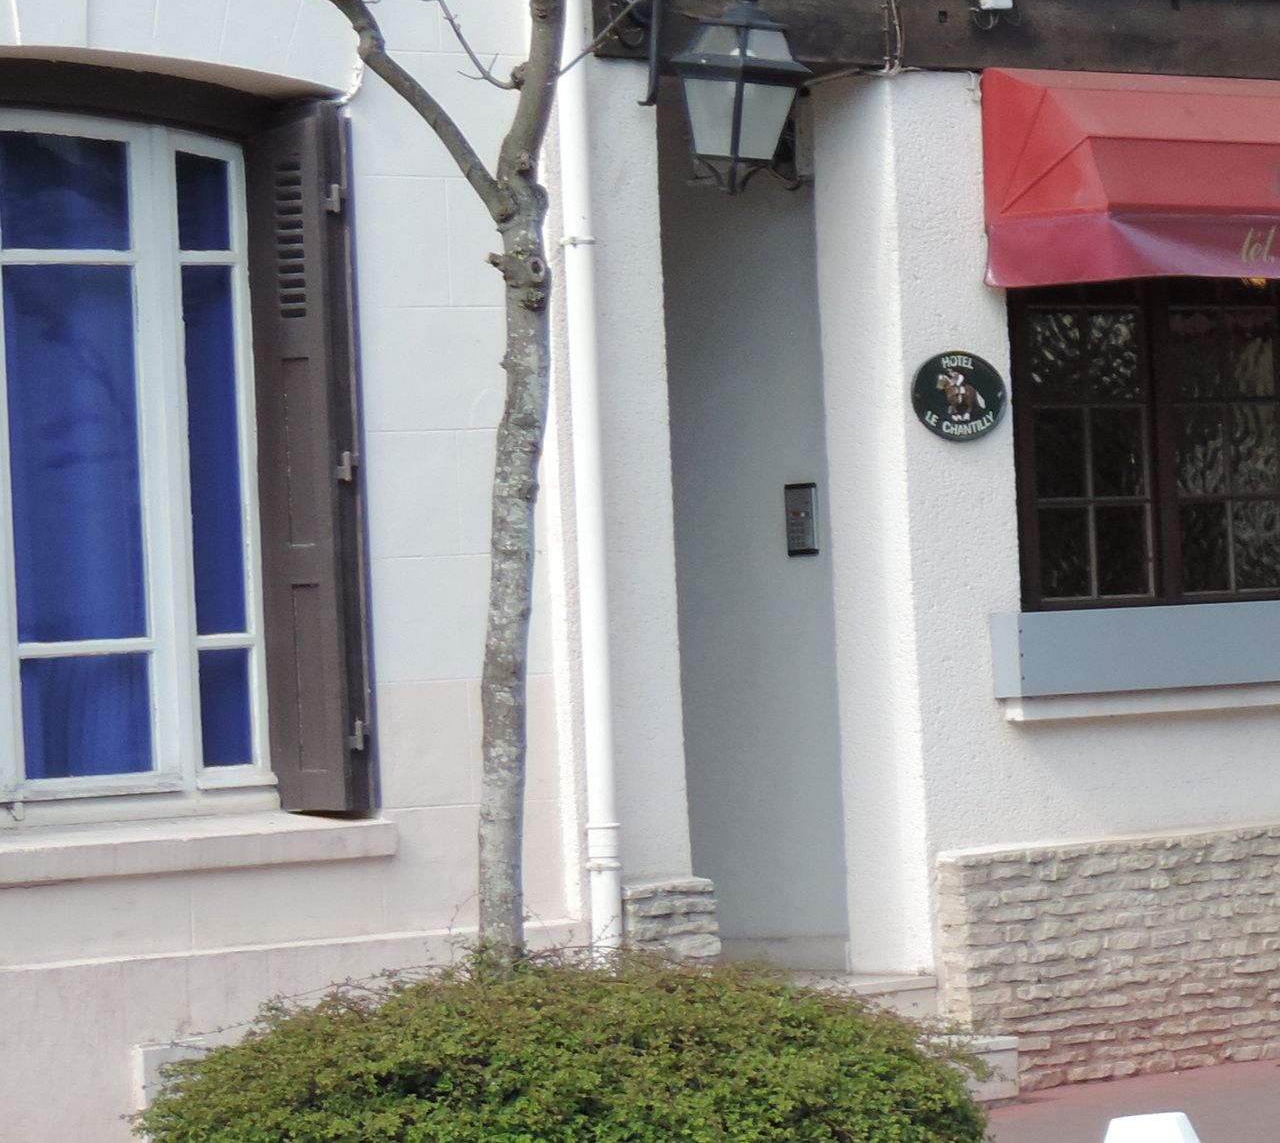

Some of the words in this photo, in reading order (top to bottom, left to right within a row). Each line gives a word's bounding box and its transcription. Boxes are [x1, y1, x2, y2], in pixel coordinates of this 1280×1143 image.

[941, 355, 975, 370] HOTEL
[925, 410, 939, 427] LE
[942, 410, 995, 436] CHANTILLY
